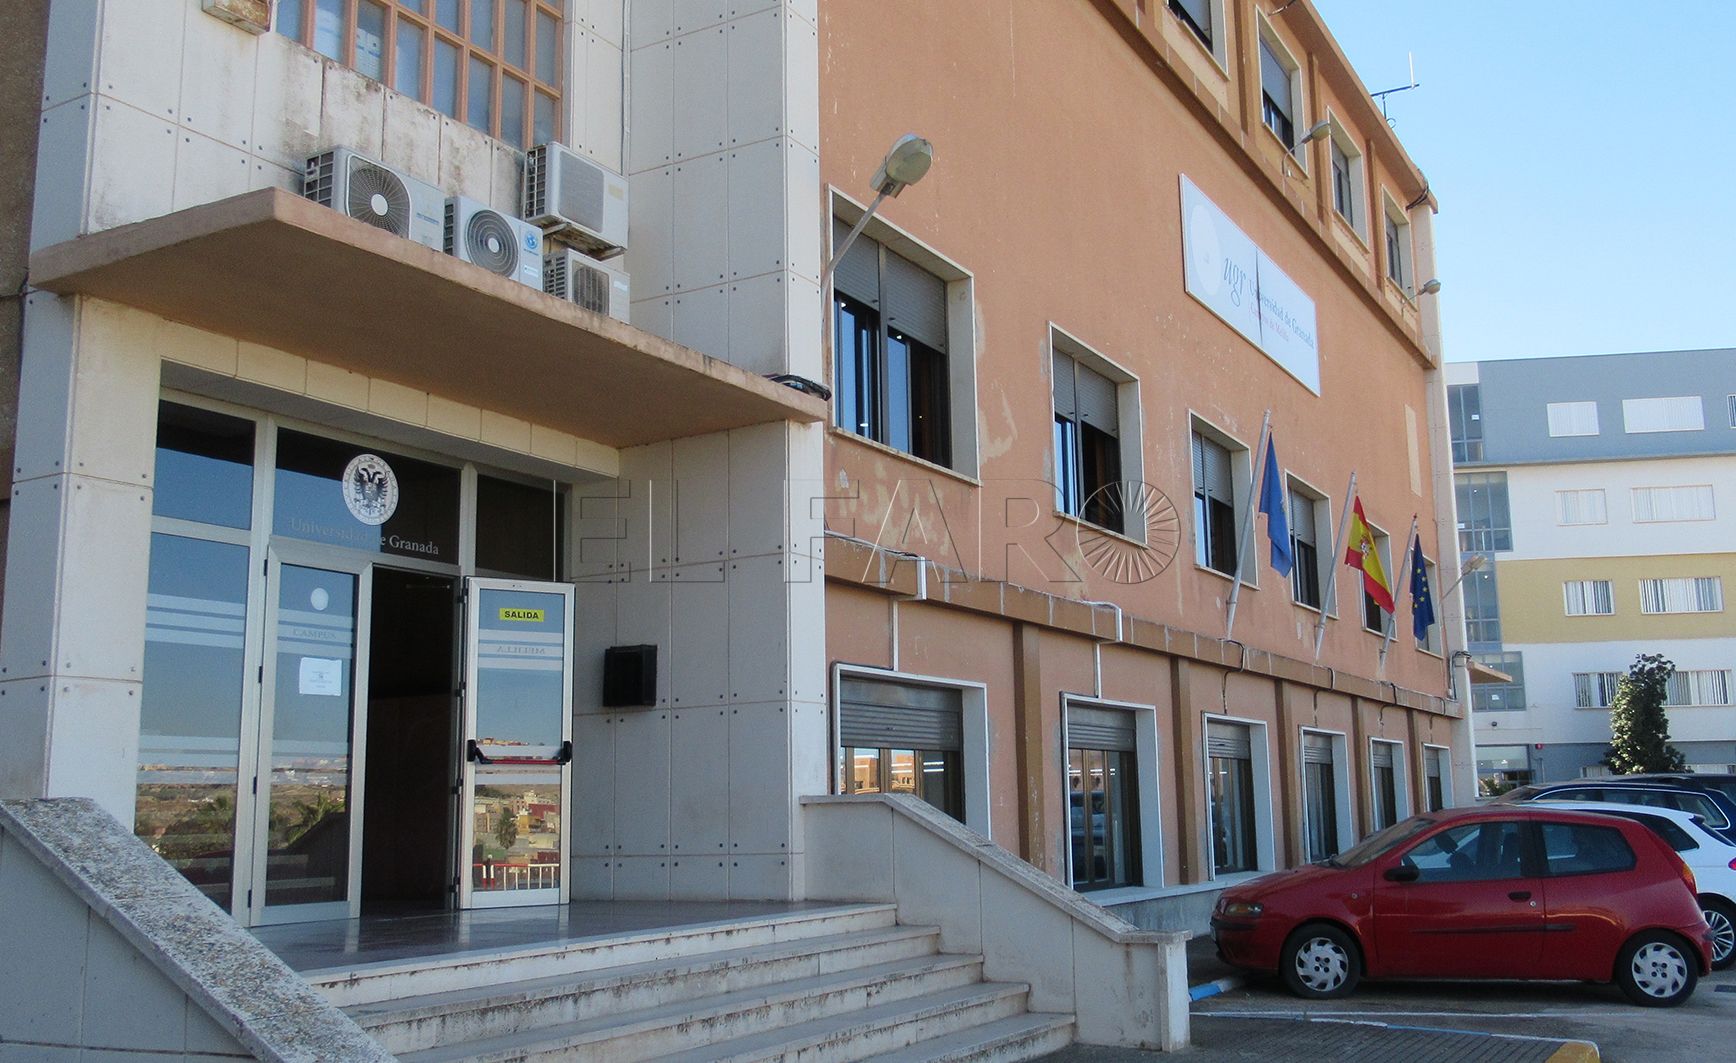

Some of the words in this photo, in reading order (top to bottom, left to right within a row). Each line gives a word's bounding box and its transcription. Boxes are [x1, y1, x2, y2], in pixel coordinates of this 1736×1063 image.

[1223, 257, 1246, 307] ugr
[389, 534, 439, 555] Granada
[504, 610, 539, 619] SALIDA
